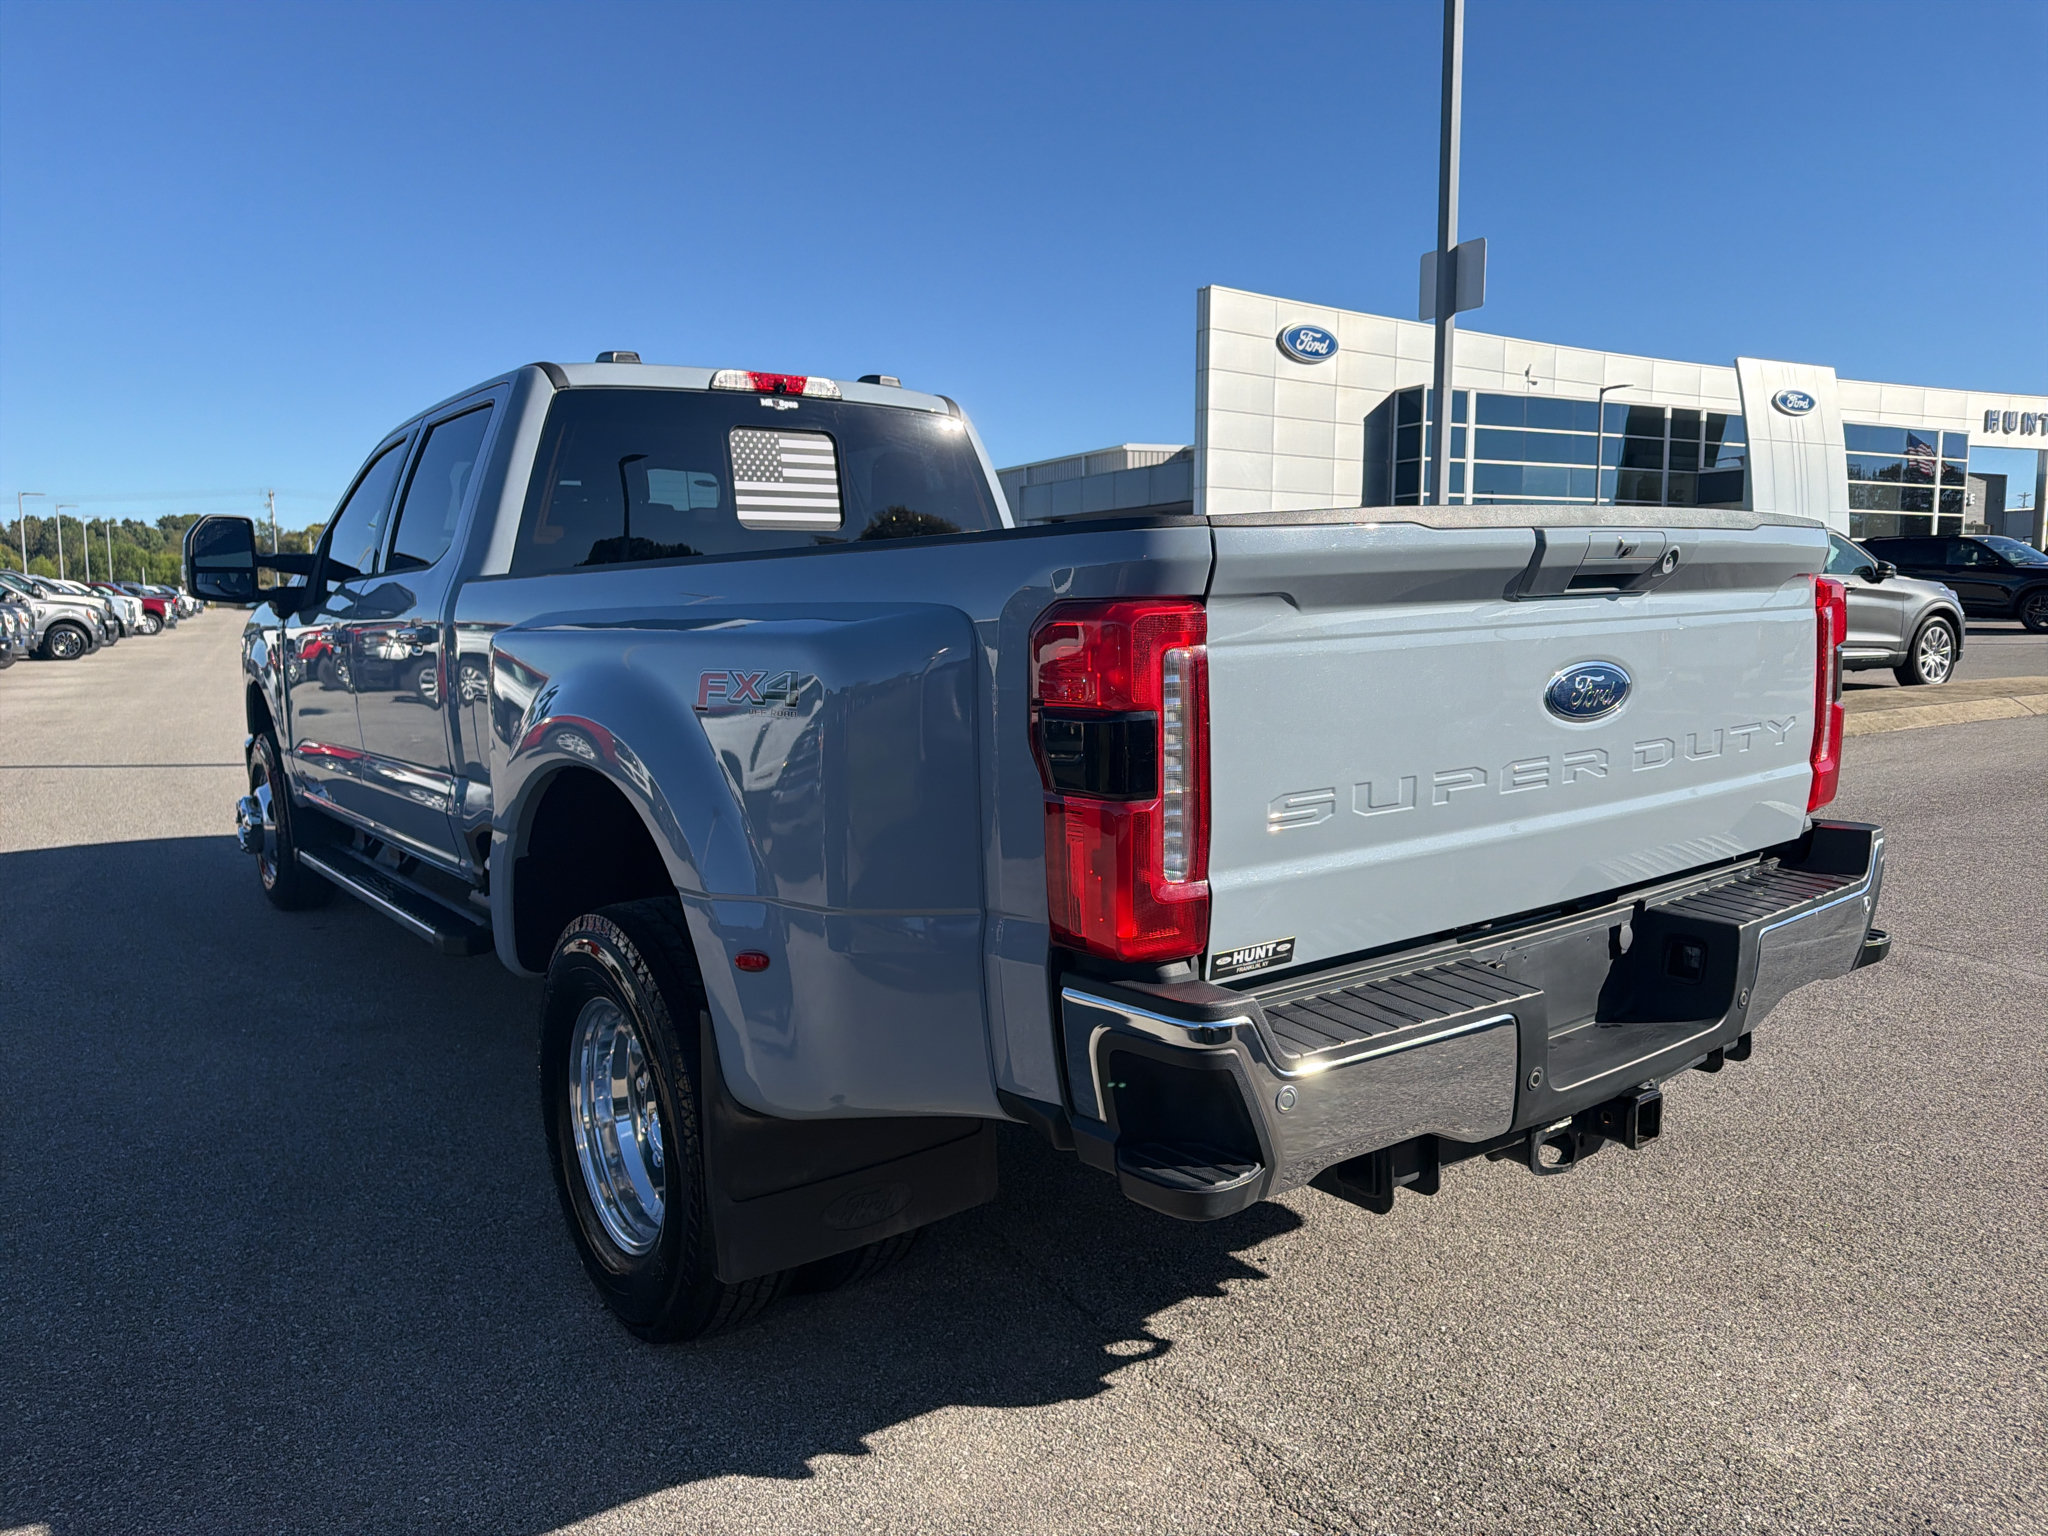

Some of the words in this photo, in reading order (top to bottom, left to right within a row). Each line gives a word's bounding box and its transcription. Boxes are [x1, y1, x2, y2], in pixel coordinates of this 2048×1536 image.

[1296, 329, 1330, 354] Ford
[1786, 393, 1810, 409] Ford
[695, 668, 800, 713] FX4
[1570, 674, 1616, 710] Ford
[1267, 747, 1609, 833] SUPER
[1632, 715, 1797, 772] DUTY
[1232, 943, 1277, 965] HUNT
